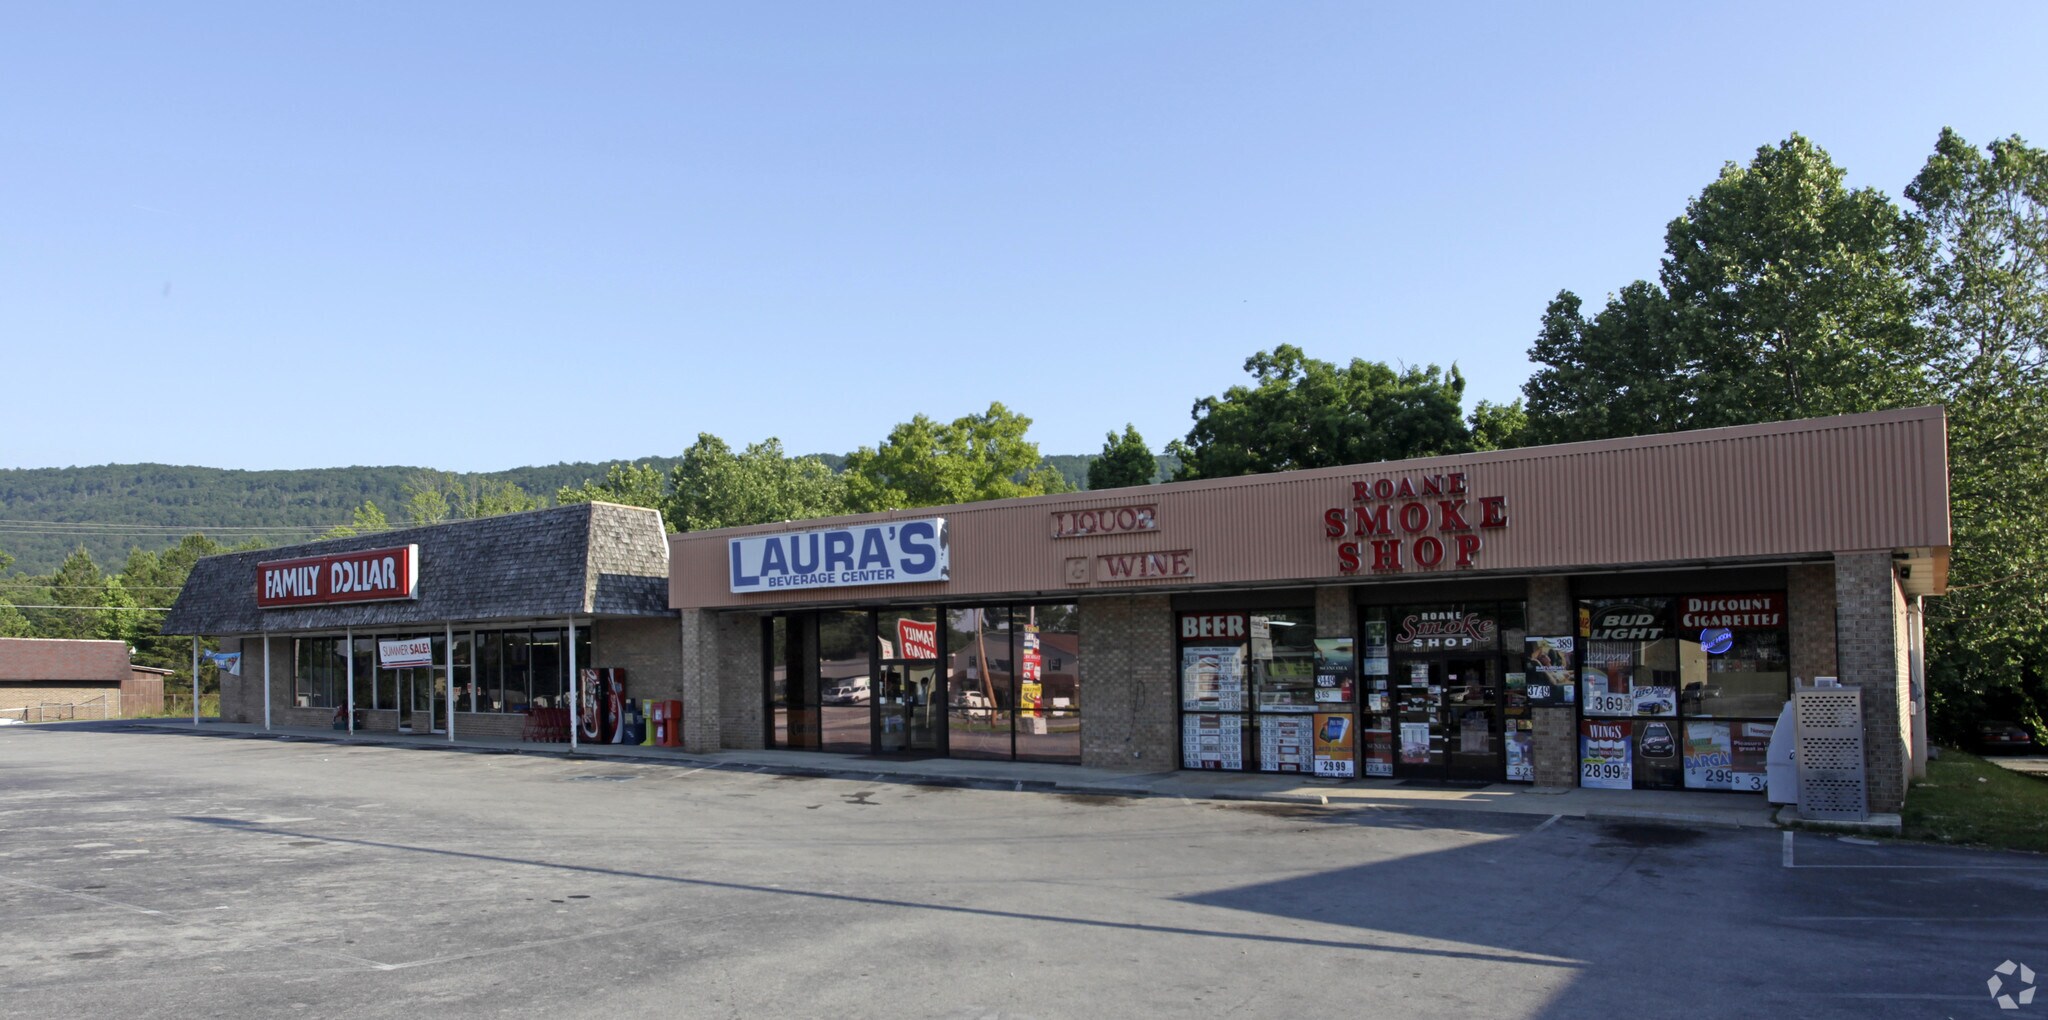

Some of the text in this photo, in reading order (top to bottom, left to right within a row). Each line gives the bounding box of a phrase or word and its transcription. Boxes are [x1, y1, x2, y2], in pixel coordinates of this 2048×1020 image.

[1352, 472, 1468, 501] ROANE
[1324, 496, 1509, 538] SMOKE
[732, 522, 937, 587] LAURA'S
[1338, 535, 1483, 572] SHOP
[1105, 551, 1190, 577] WINE
[265, 556, 396, 599] FAMILY DOLLAR
[768, 569, 895, 587] BEVERAGE CENTER
[1421, 611, 1462, 620] ROANE
[1602, 614, 1655, 627] BUD
[1182, 615, 1244, 638] BEER
[1396, 612, 1494, 643] Smoke
[1590, 628, 1664, 639] LIGHT
[383, 643, 431, 656] SUMMER SALE!
[1413, 638, 1473, 648] SHOP
[1589, 724, 1622, 738] WINGS
[1584, 763, 1620, 779] 28.99
